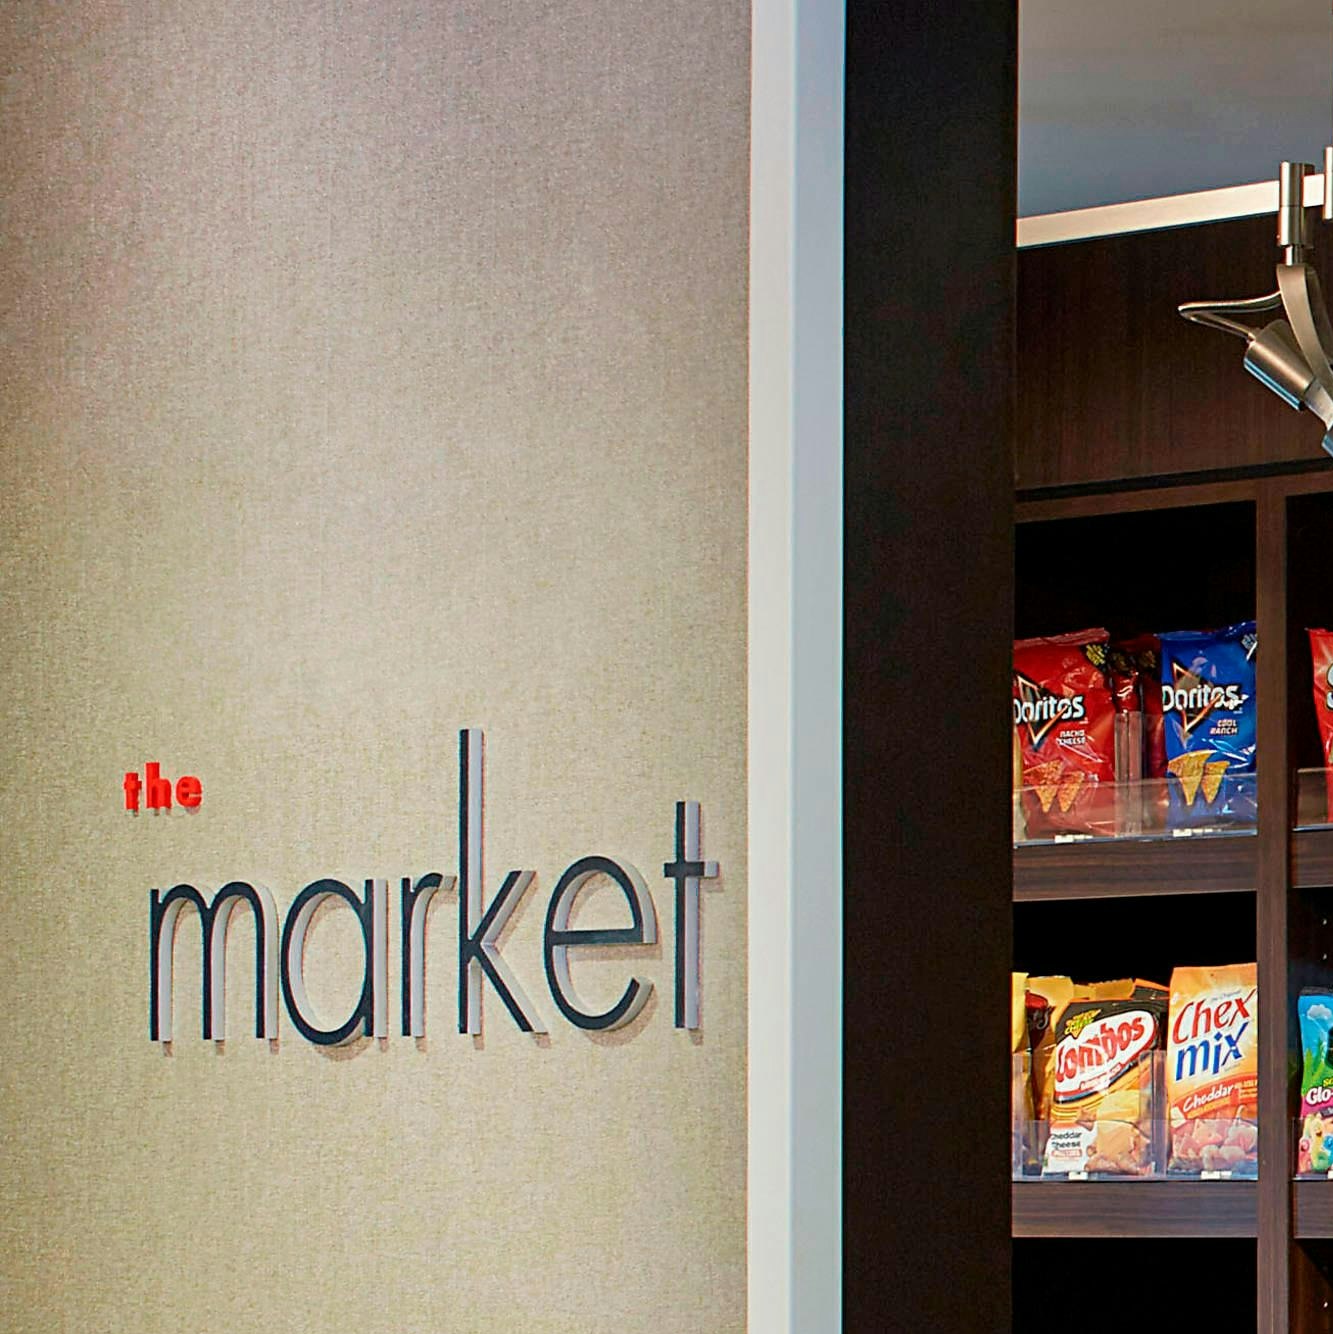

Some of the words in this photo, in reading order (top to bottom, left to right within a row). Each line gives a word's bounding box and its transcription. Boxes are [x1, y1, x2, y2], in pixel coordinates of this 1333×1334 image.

[1013, 695, 1085, 725] Doritos
[1160, 684, 1241, 713] Doritos
[124, 761, 204, 812] the
[149, 728, 720, 1046] market
[1172, 988, 1257, 1045] Chex
[1055, 1016, 1147, 1083] Combos
[1175, 1021, 1250, 1082] mix
[1182, 1083, 1234, 1114] Cheddar
